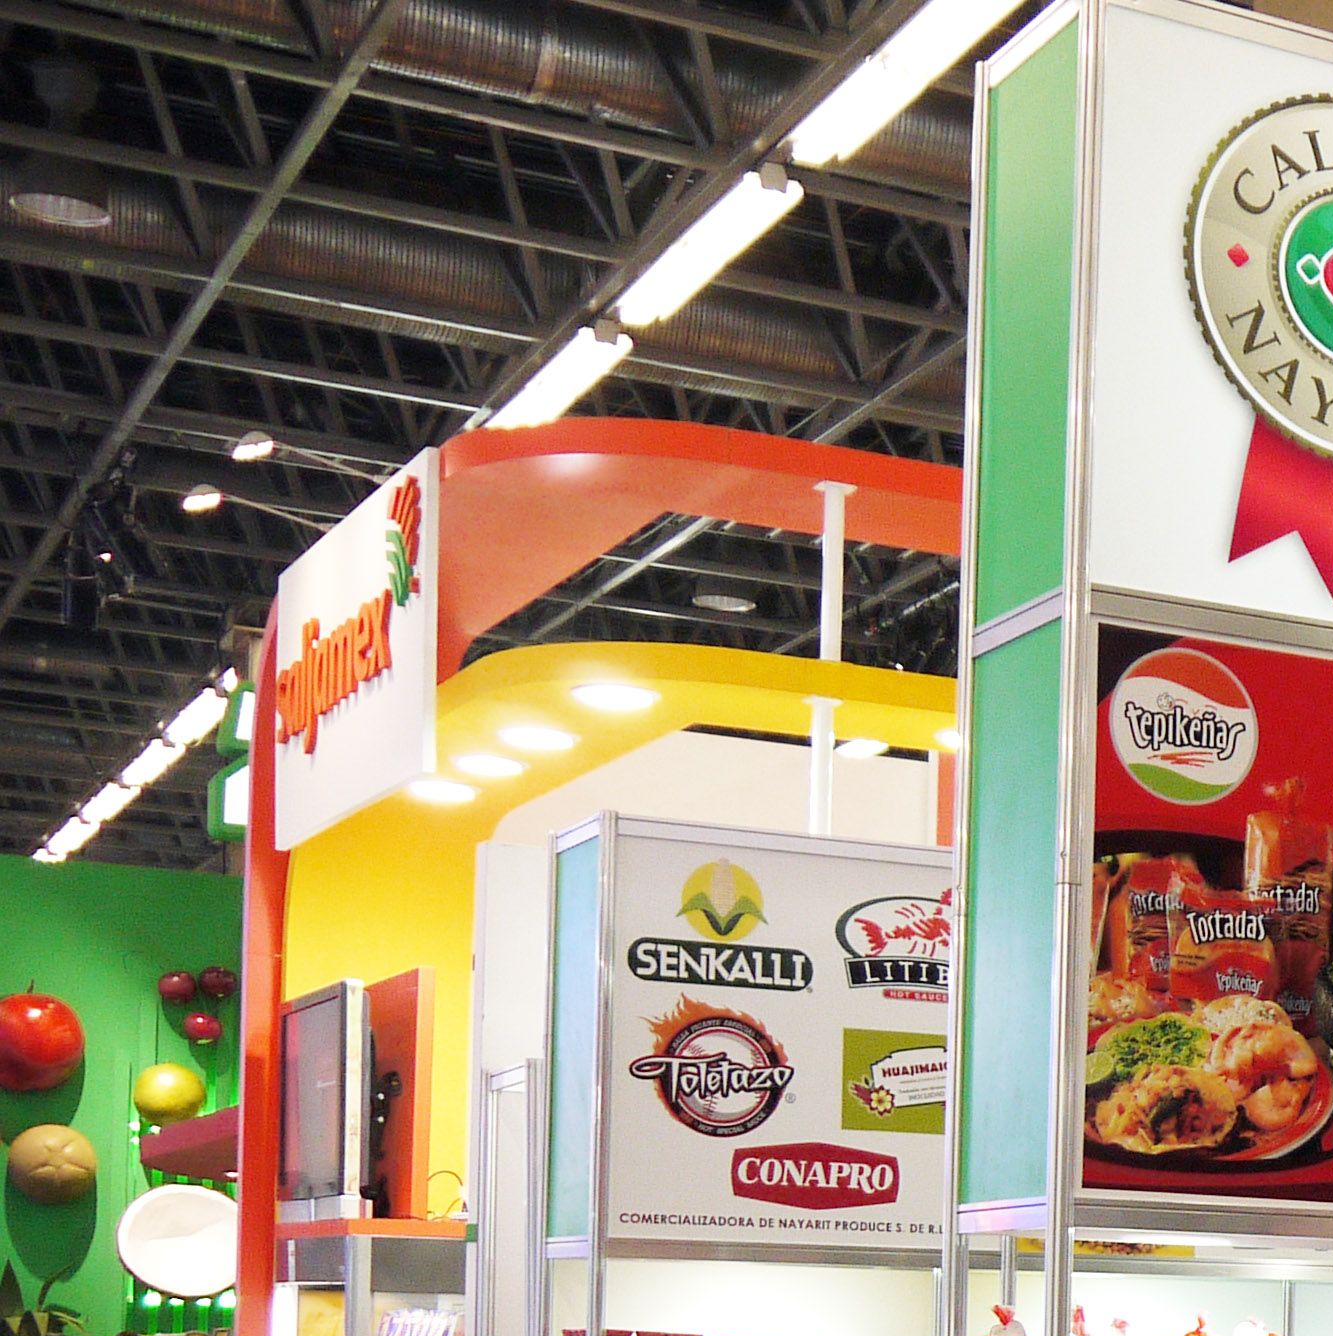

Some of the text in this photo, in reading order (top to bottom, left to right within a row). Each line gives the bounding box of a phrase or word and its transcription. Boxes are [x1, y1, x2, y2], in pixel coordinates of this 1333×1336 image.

[1186, 910, 1267, 945] Tostadas
[635, 942, 807, 988] SENKALLI
[889, 990, 911, 999] HOT
[737, 1156, 893, 1195] CONAPRO
[619, 1212, 755, 1228] COMERCIALIZADORA
[759, 1217, 775, 1229] DE
[779, 1217, 831, 1231] NAYARIT
[835, 1220, 892, 1233] PRODUCE
[910, 1222, 925, 1234] DE
